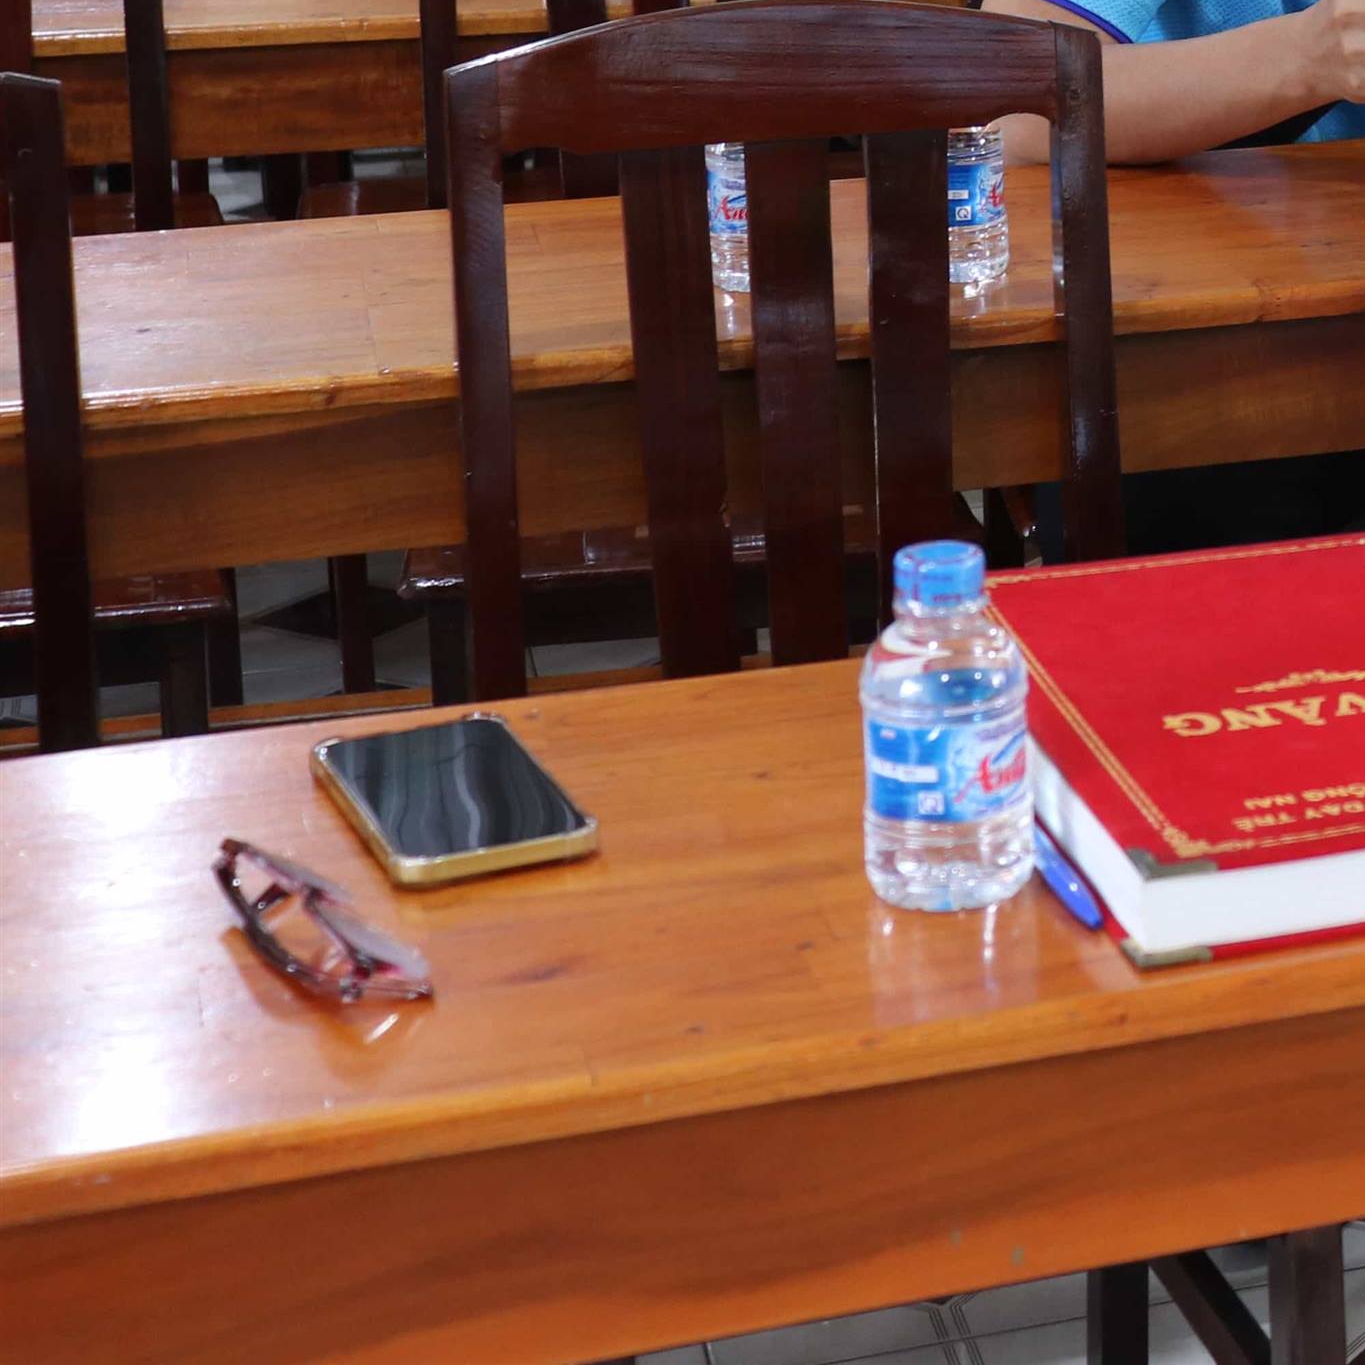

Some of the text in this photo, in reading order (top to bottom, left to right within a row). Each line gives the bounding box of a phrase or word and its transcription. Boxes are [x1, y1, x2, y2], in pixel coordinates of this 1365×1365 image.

[1243, 793, 1297, 811] NAI
[1303, 799, 1365, 820] DẠY
[1232, 810, 1297, 833] TRẺ
